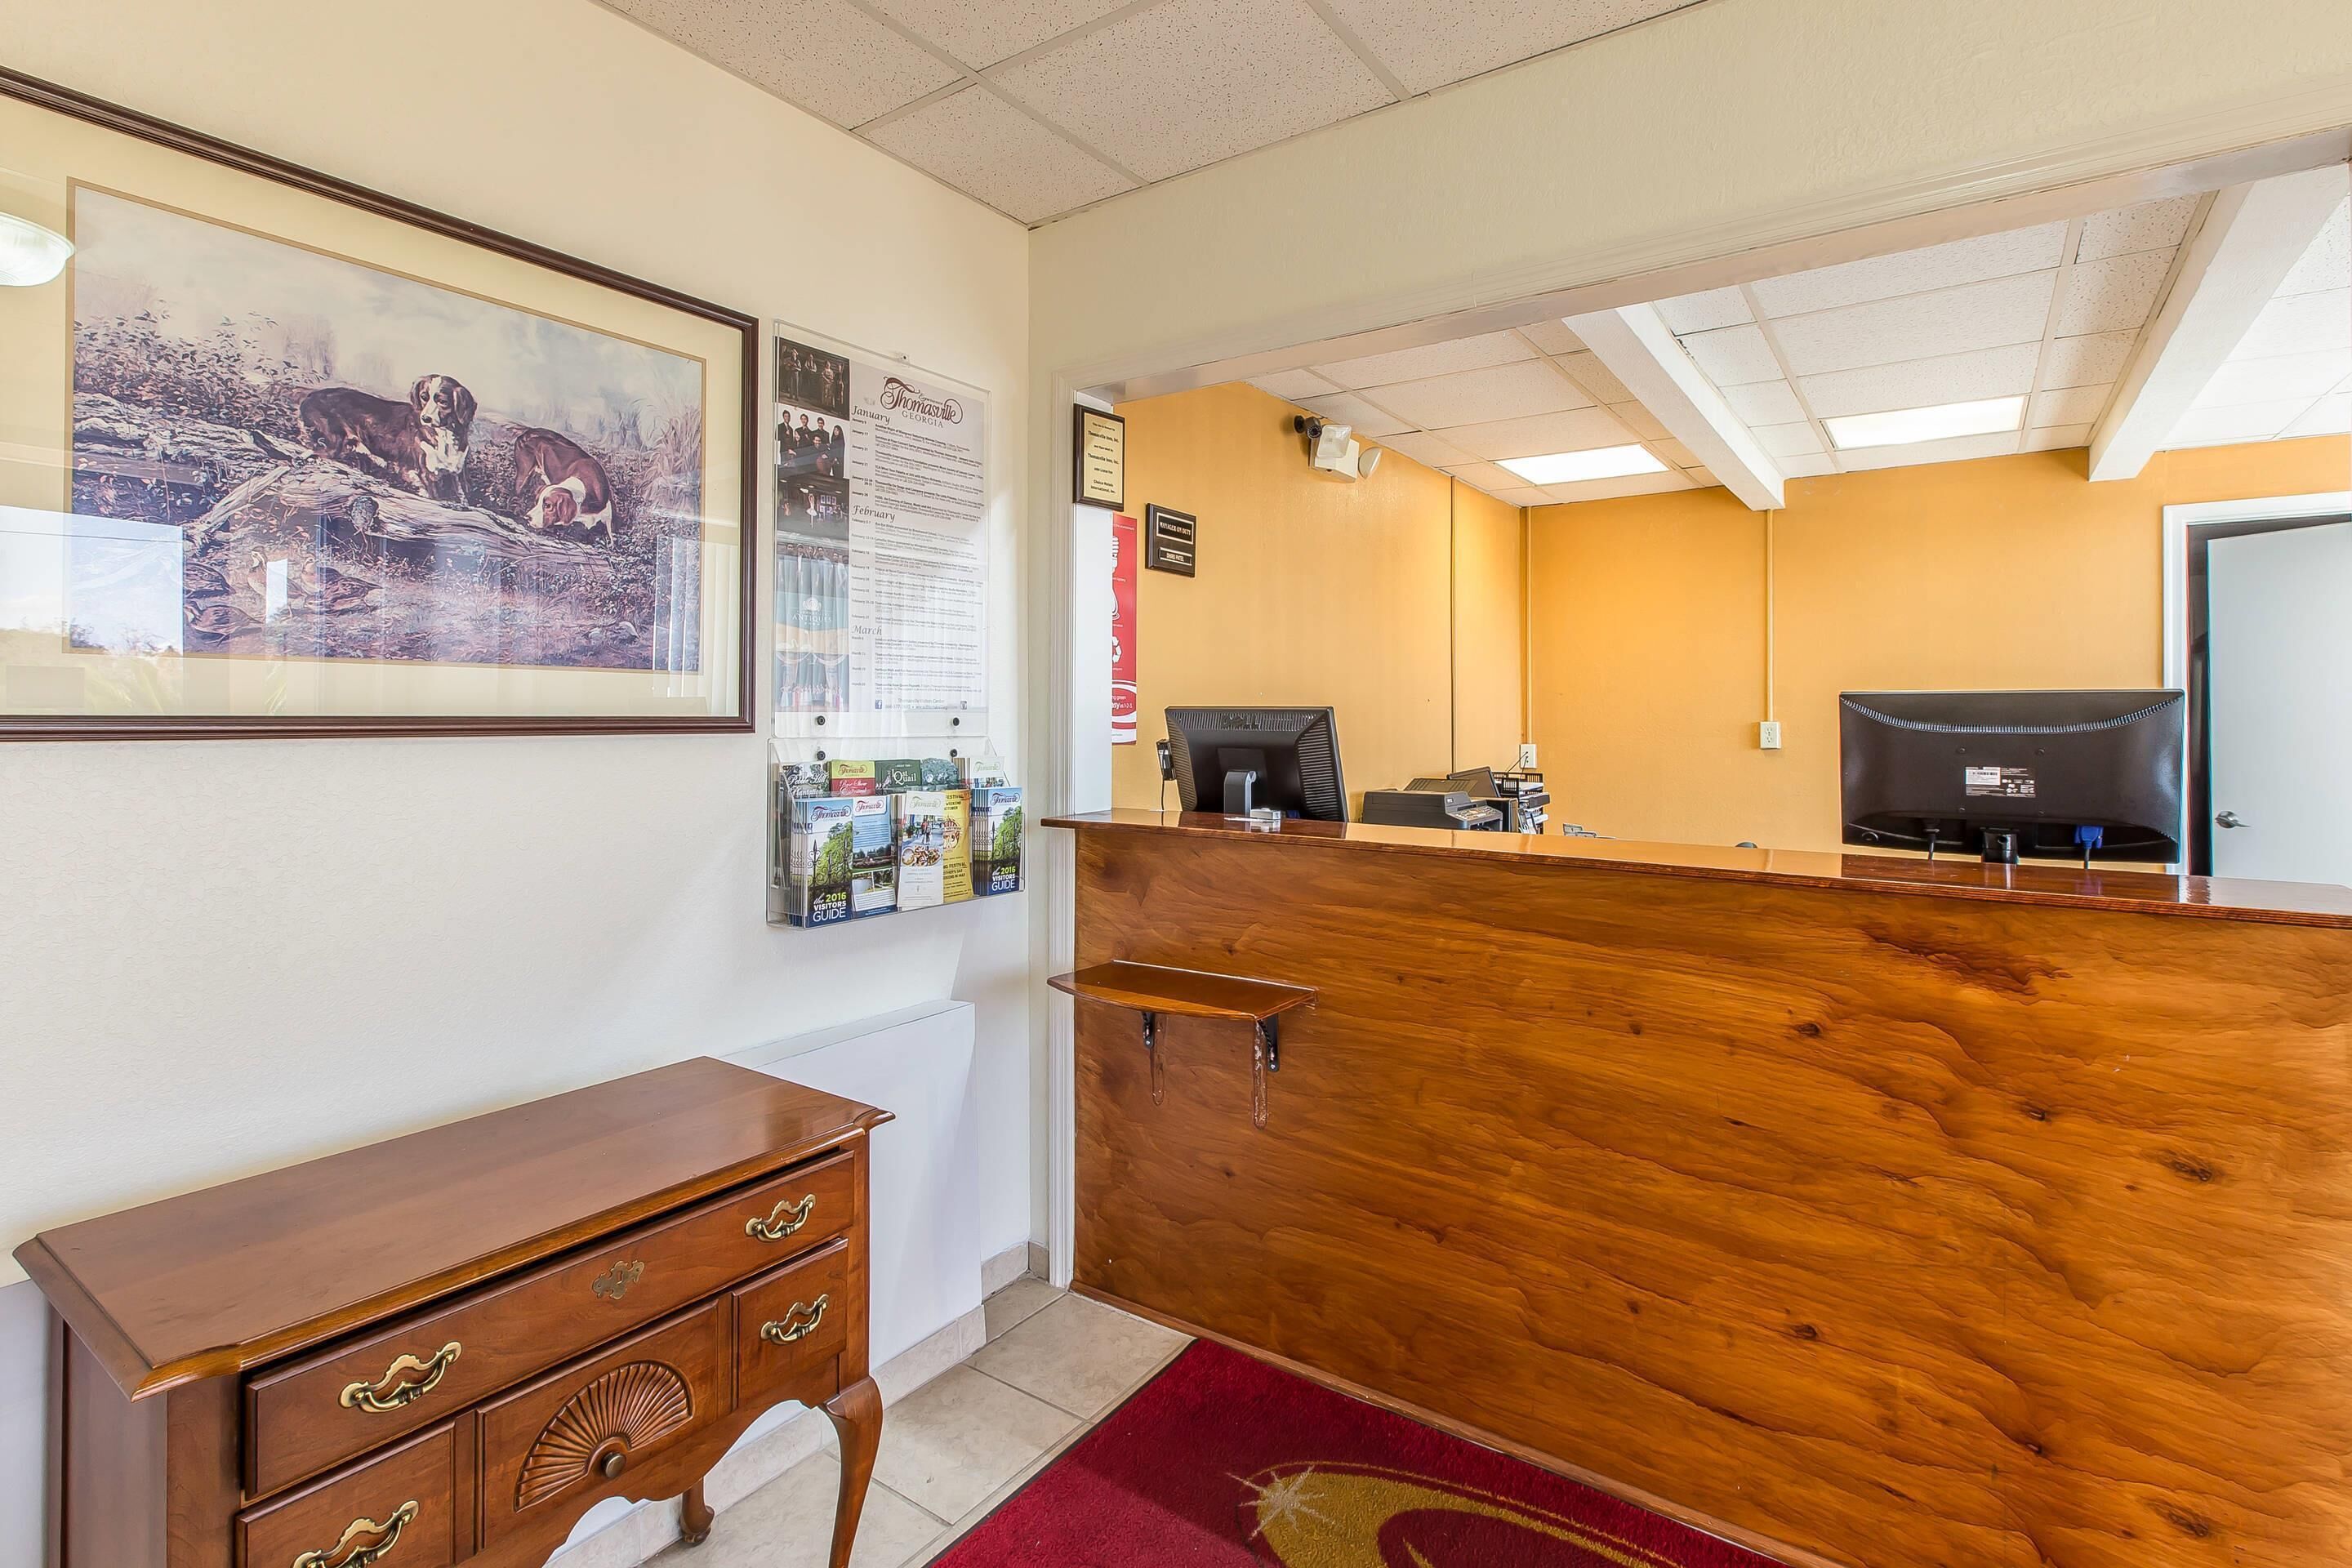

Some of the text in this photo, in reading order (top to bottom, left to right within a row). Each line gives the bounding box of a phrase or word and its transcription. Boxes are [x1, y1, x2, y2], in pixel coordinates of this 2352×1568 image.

[880, 376, 964, 425] Thomasville
[851, 405, 890, 425] January
[902, 410, 944, 429] GEORGIA
[852, 505, 896, 523] February
[1160, 521, 1177, 532] MANAGER
[1182, 528, 1192, 536] DUTY
[851, 625, 882, 635] March
[893, 770, 916, 786] Quail
[992, 873, 1015, 882] VISITORS
[1000, 866, 1016, 875] 2016
[991, 879, 1016, 892] GUIDE
[813, 892, 825, 905] the
[825, 892, 847, 902] 2016
[813, 900, 847, 911] VISITORS
[813, 906, 847, 922] GUIDE
